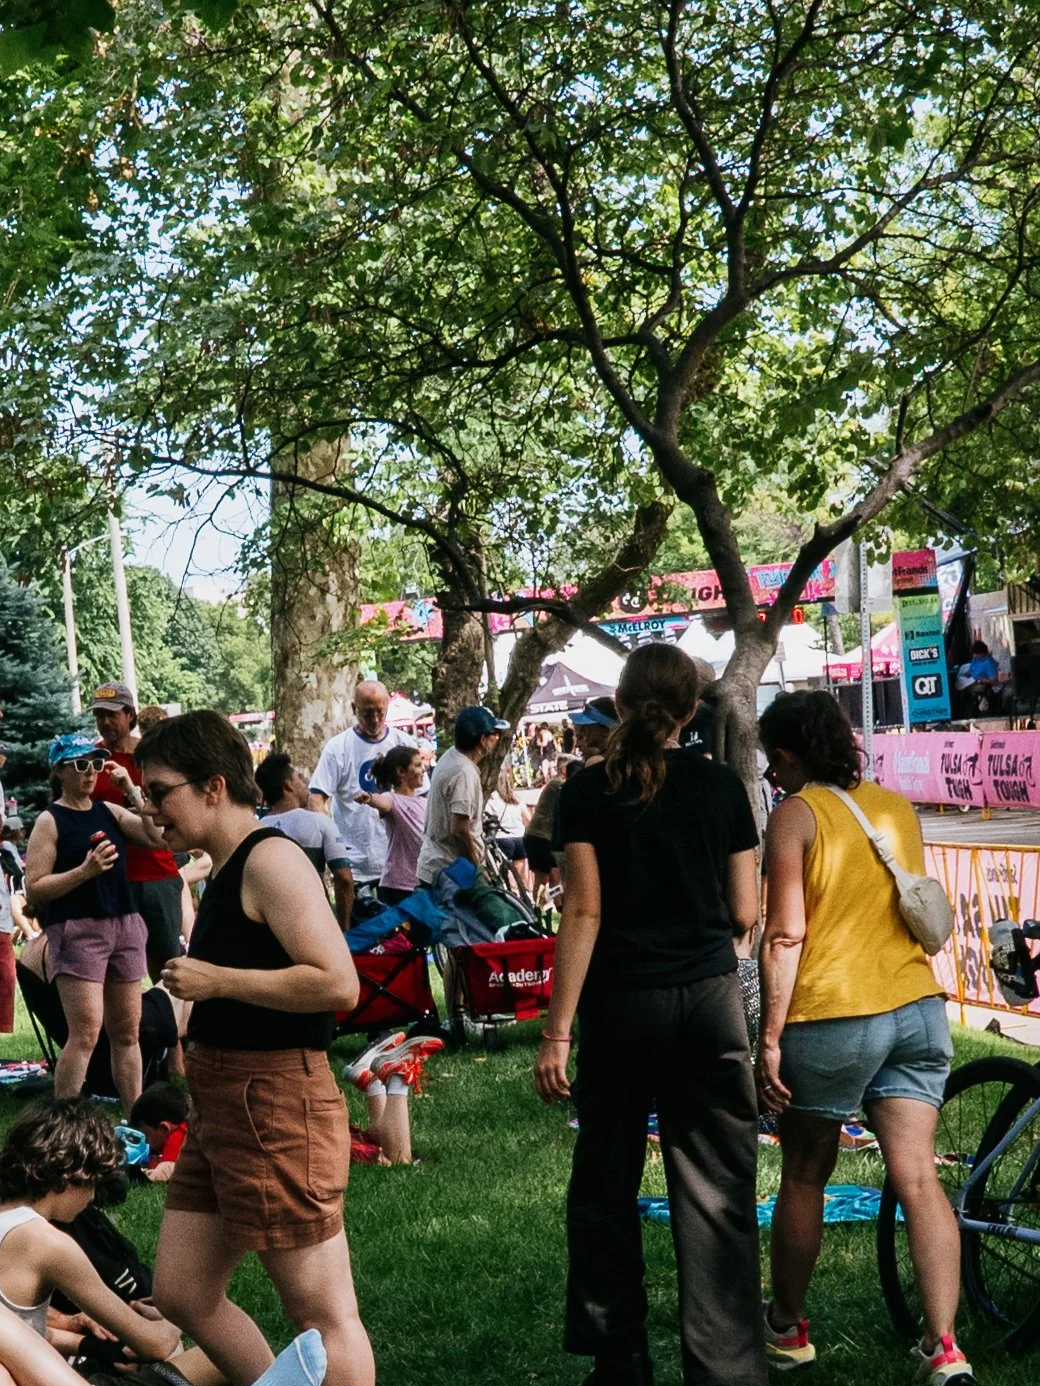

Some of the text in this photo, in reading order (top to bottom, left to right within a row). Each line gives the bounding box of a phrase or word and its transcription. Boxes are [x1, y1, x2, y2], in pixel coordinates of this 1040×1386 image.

[911, 648, 938, 660] DICK'S
[914, 677, 937, 695] QT
[988, 754, 1018, 776] TULSA
